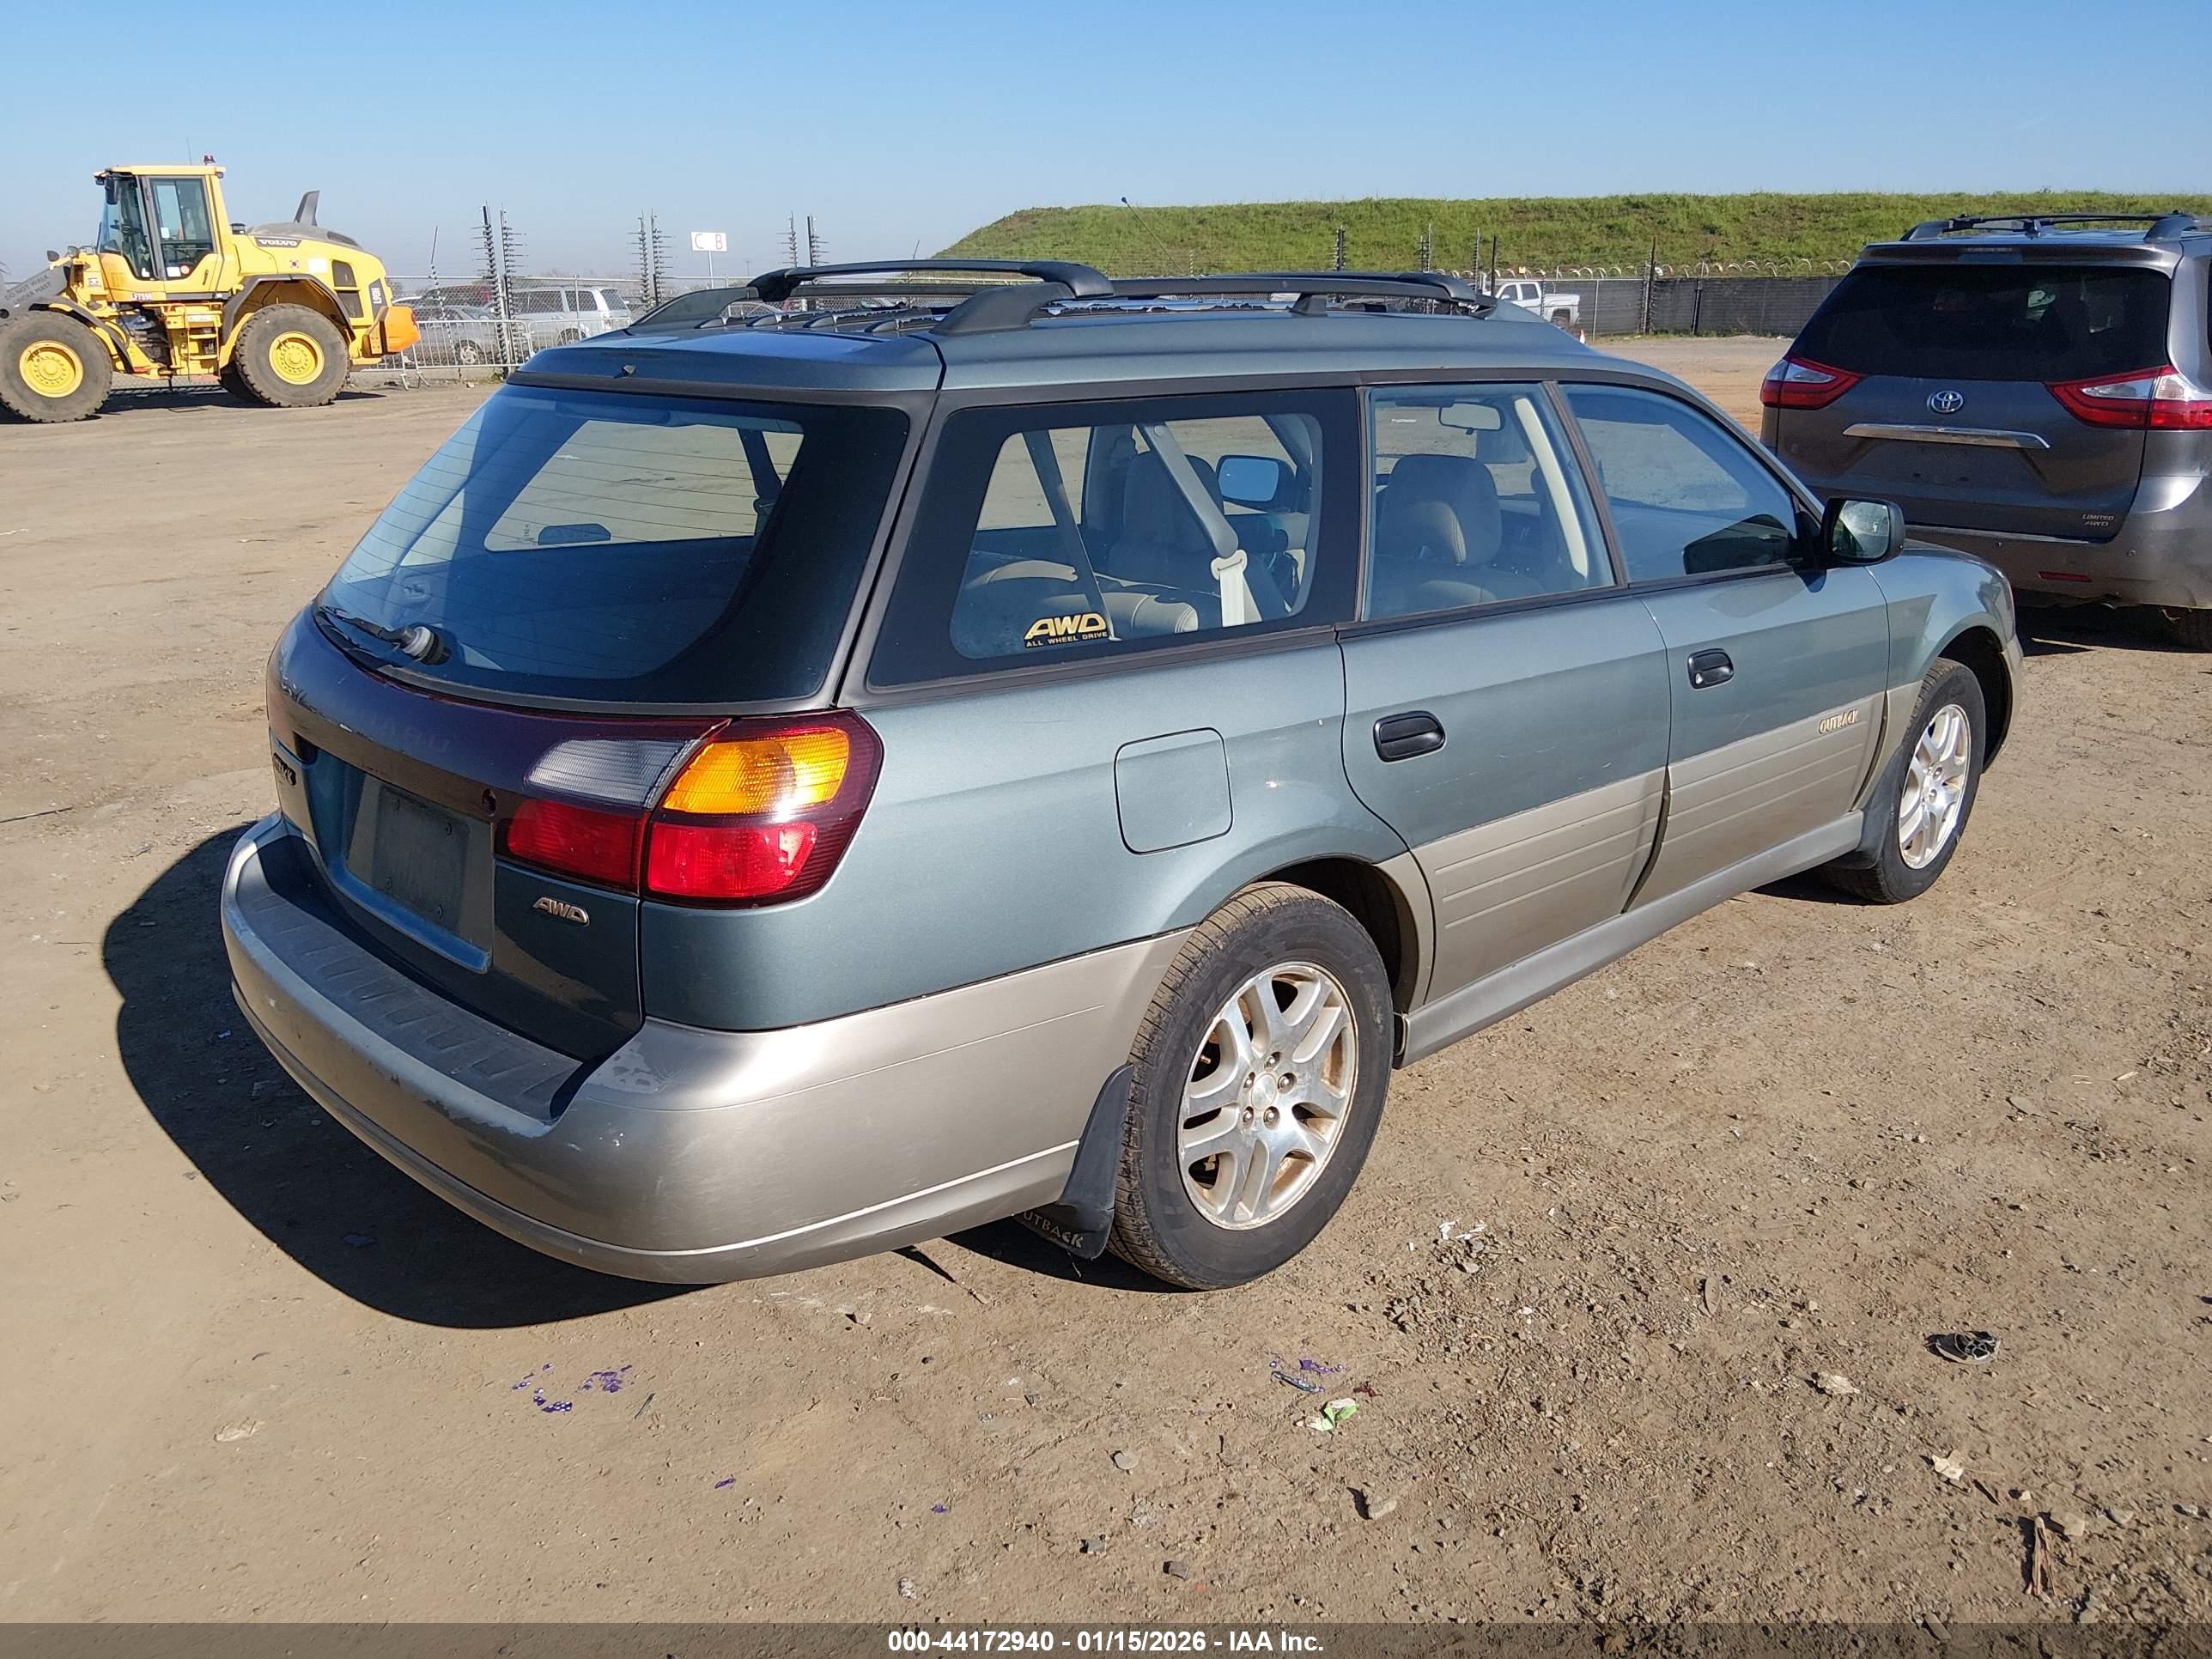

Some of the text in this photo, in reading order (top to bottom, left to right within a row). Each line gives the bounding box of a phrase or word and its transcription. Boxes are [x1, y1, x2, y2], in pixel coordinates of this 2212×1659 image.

[694, 233, 723, 250] C B
[1024, 613, 1107, 640] AWD
[1048, 635, 1079, 644] WHEEL
[1082, 631, 1108, 640] DRIVE
[1819, 709, 1859, 735] OUTBACK
[532, 896, 590, 927] AWD
[1023, 1211, 1084, 1249] UTBACK
